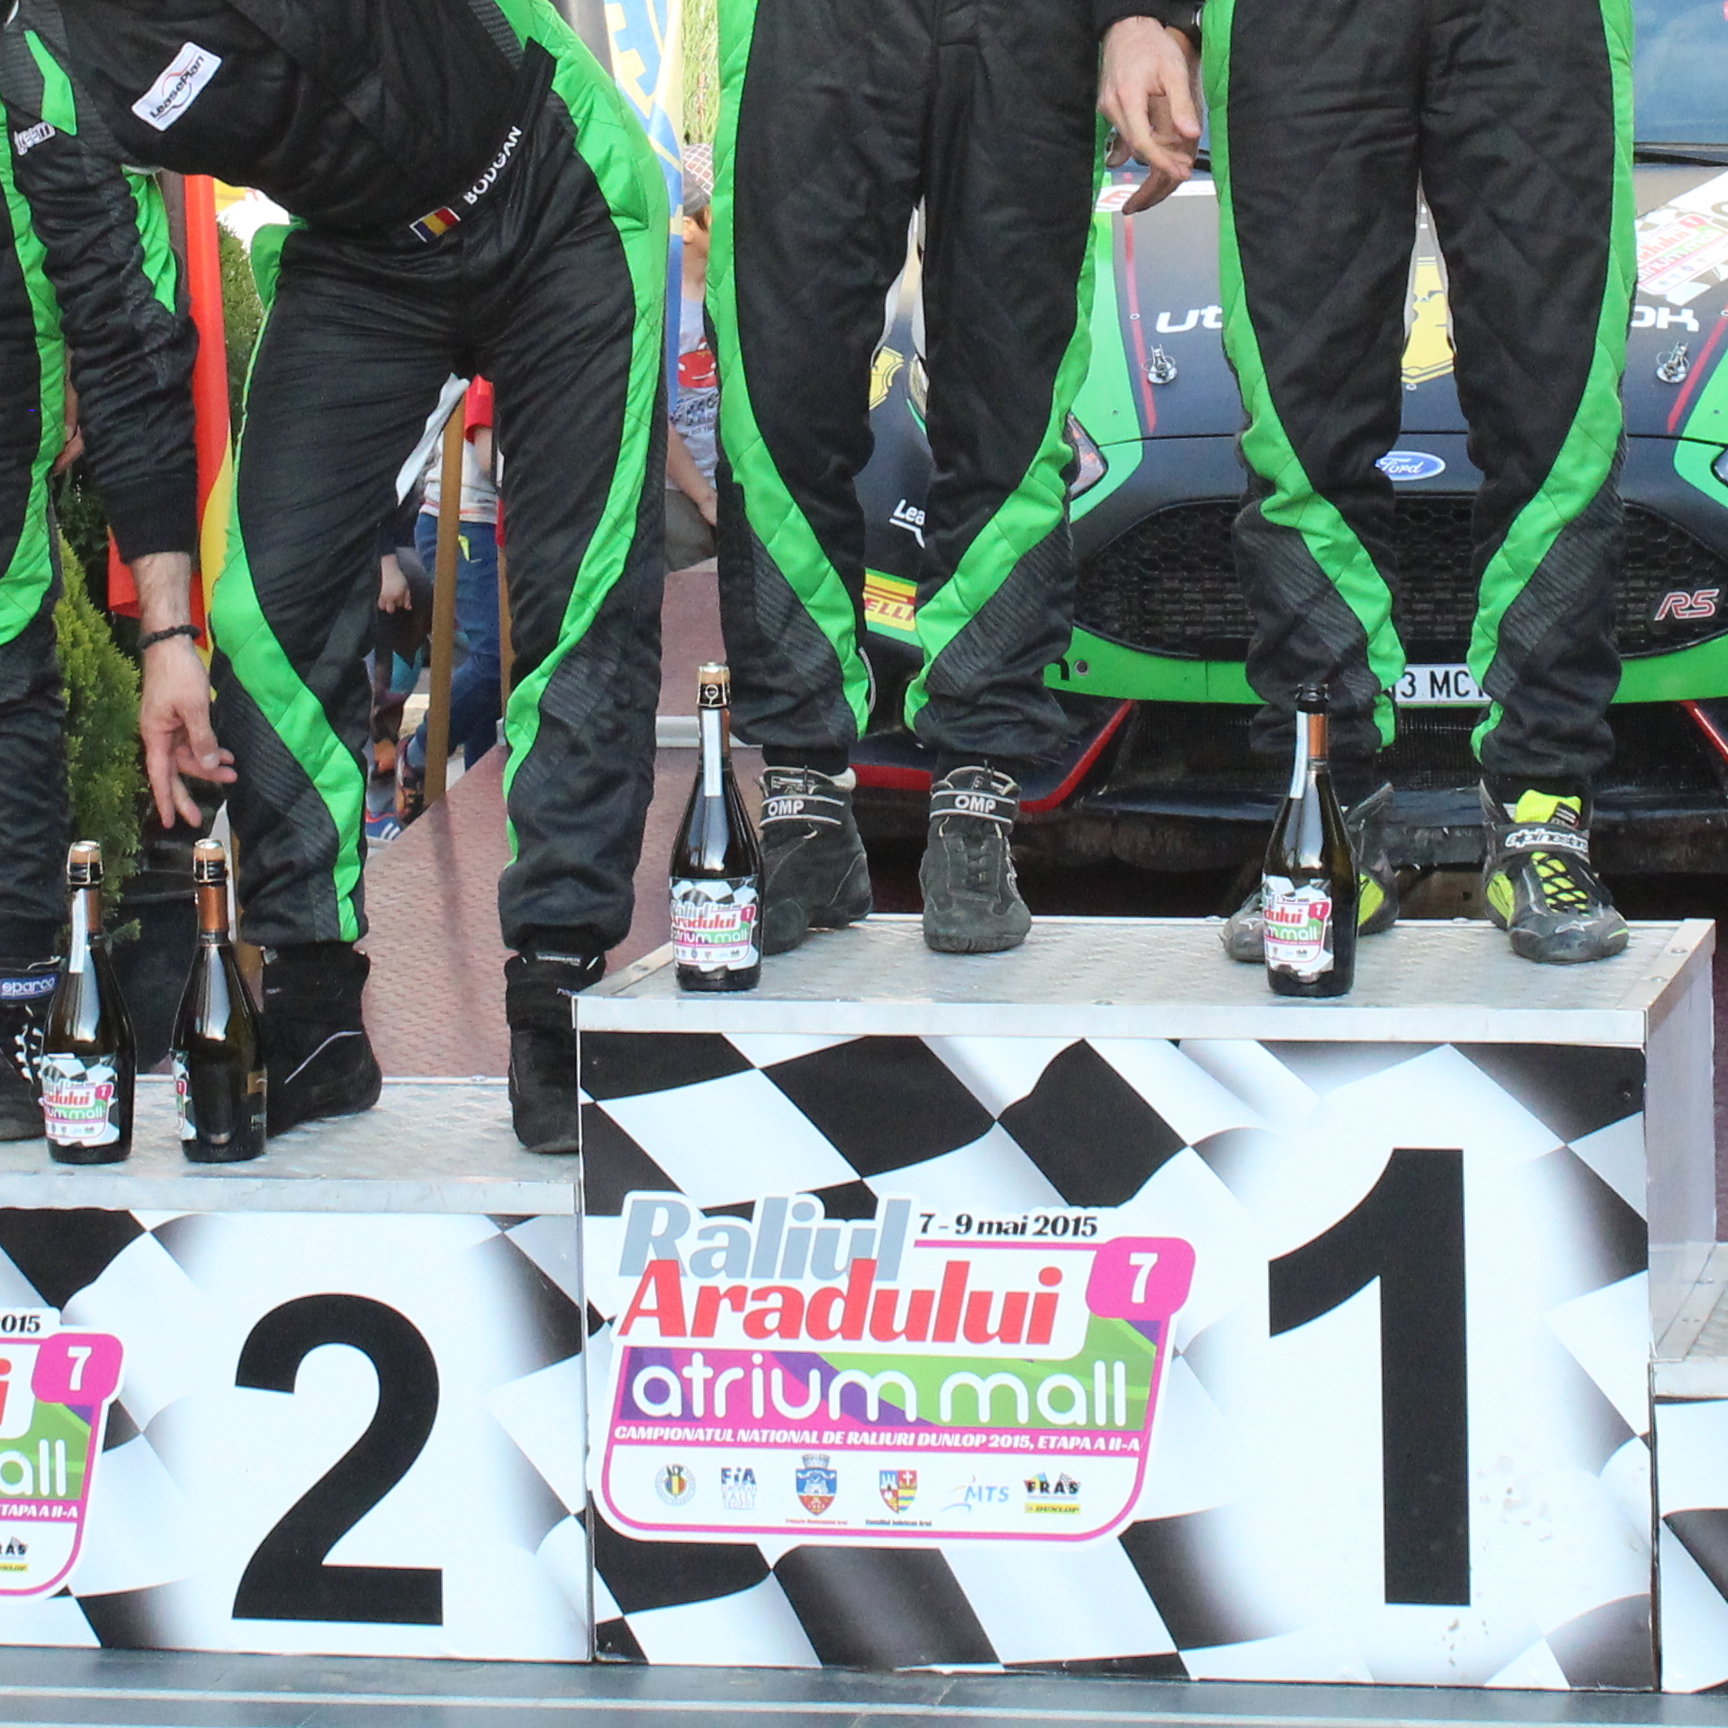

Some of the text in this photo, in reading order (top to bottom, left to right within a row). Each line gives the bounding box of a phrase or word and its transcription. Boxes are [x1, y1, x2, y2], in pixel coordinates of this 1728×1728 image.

[150, 55, 204, 118] LeasePlan
[1378, 457, 1423, 476] Ford
[1655, 588, 1721, 621] RS
[768, 799, 805, 817] OMP
[955, 795, 997, 814] OMP
[715, 930, 748, 944] mall
[1281, 925, 1318, 941] mall
[0, 977, 56, 998] sparco
[69, 1108, 104, 1120] mall
[919, 1213, 1099, 1237] 7 9 mai 2015
[618, 1196, 912, 1282] Raliul
[1128, 1252, 1158, 1304] 7
[618, 1257, 1063, 1345] Aradului
[68, 1347, 93, 1391] 7
[1268, 1146, 1471, 1607] 1
[632, 1351, 1126, 1426] atrium mall
[614, 1426, 1140, 1451] CAMPIONATUL NATIONAL DE RALIURI DUNLOP 2015, ETAPA A II-A
[231, 1292, 444, 1627] 2
[722, 1491, 758, 1501] RALLY
[964, 1486, 1010, 1503] MTS
[1025, 1479, 1081, 1494] FRAS
[39, 1506, 49, 1517] A
[51, 1506, 78, 1518] II-A
[1034, 1504, 1080, 1513] DUNLOP
